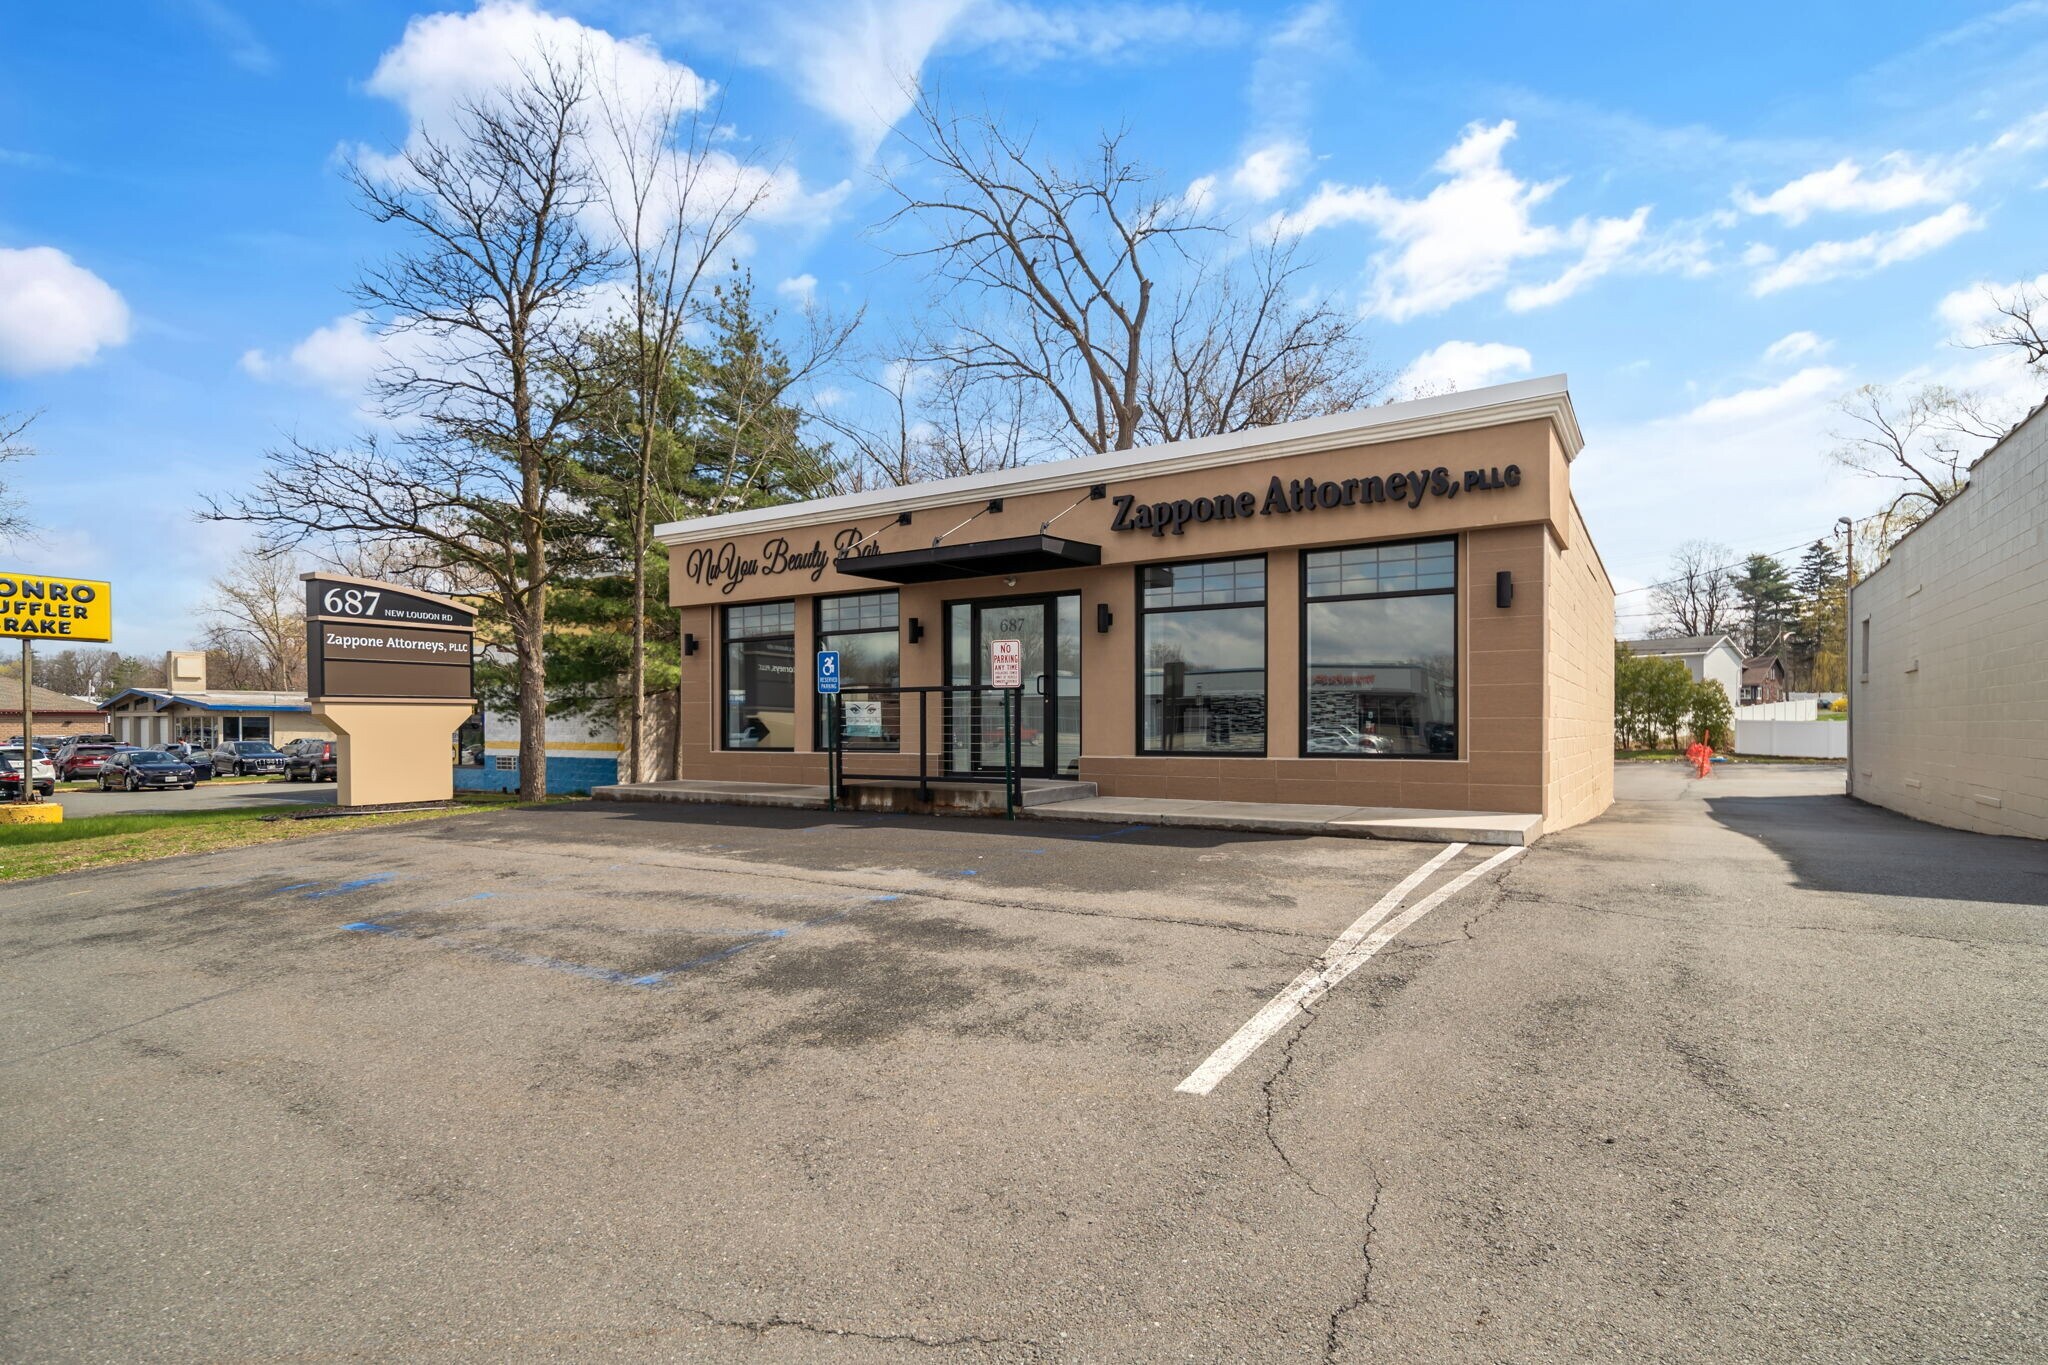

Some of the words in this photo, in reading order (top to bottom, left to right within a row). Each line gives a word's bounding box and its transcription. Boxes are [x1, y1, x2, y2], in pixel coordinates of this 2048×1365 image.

[1110, 491, 1256, 537] Zappone
[1260, 466, 1461, 515] Attorneys,
[1463, 464, 1522, 492] PLLC
[762, 537, 829, 582] Beauty
[324, 587, 381, 616] 687
[384, 609, 404, 618] NEW
[406, 611, 440, 621] LOUDON
[441, 613, 453, 622] RD
[0, 617, 72, 634] RAKE
[1000, 618, 1025, 632] 687
[326, 633, 384, 649] Zappone
[386, 637, 447, 653] Attorneys,
[449, 643, 468, 652] PLLC
[1000, 644, 1011, 653] NO
[993, 655, 1018, 663] PARKING
